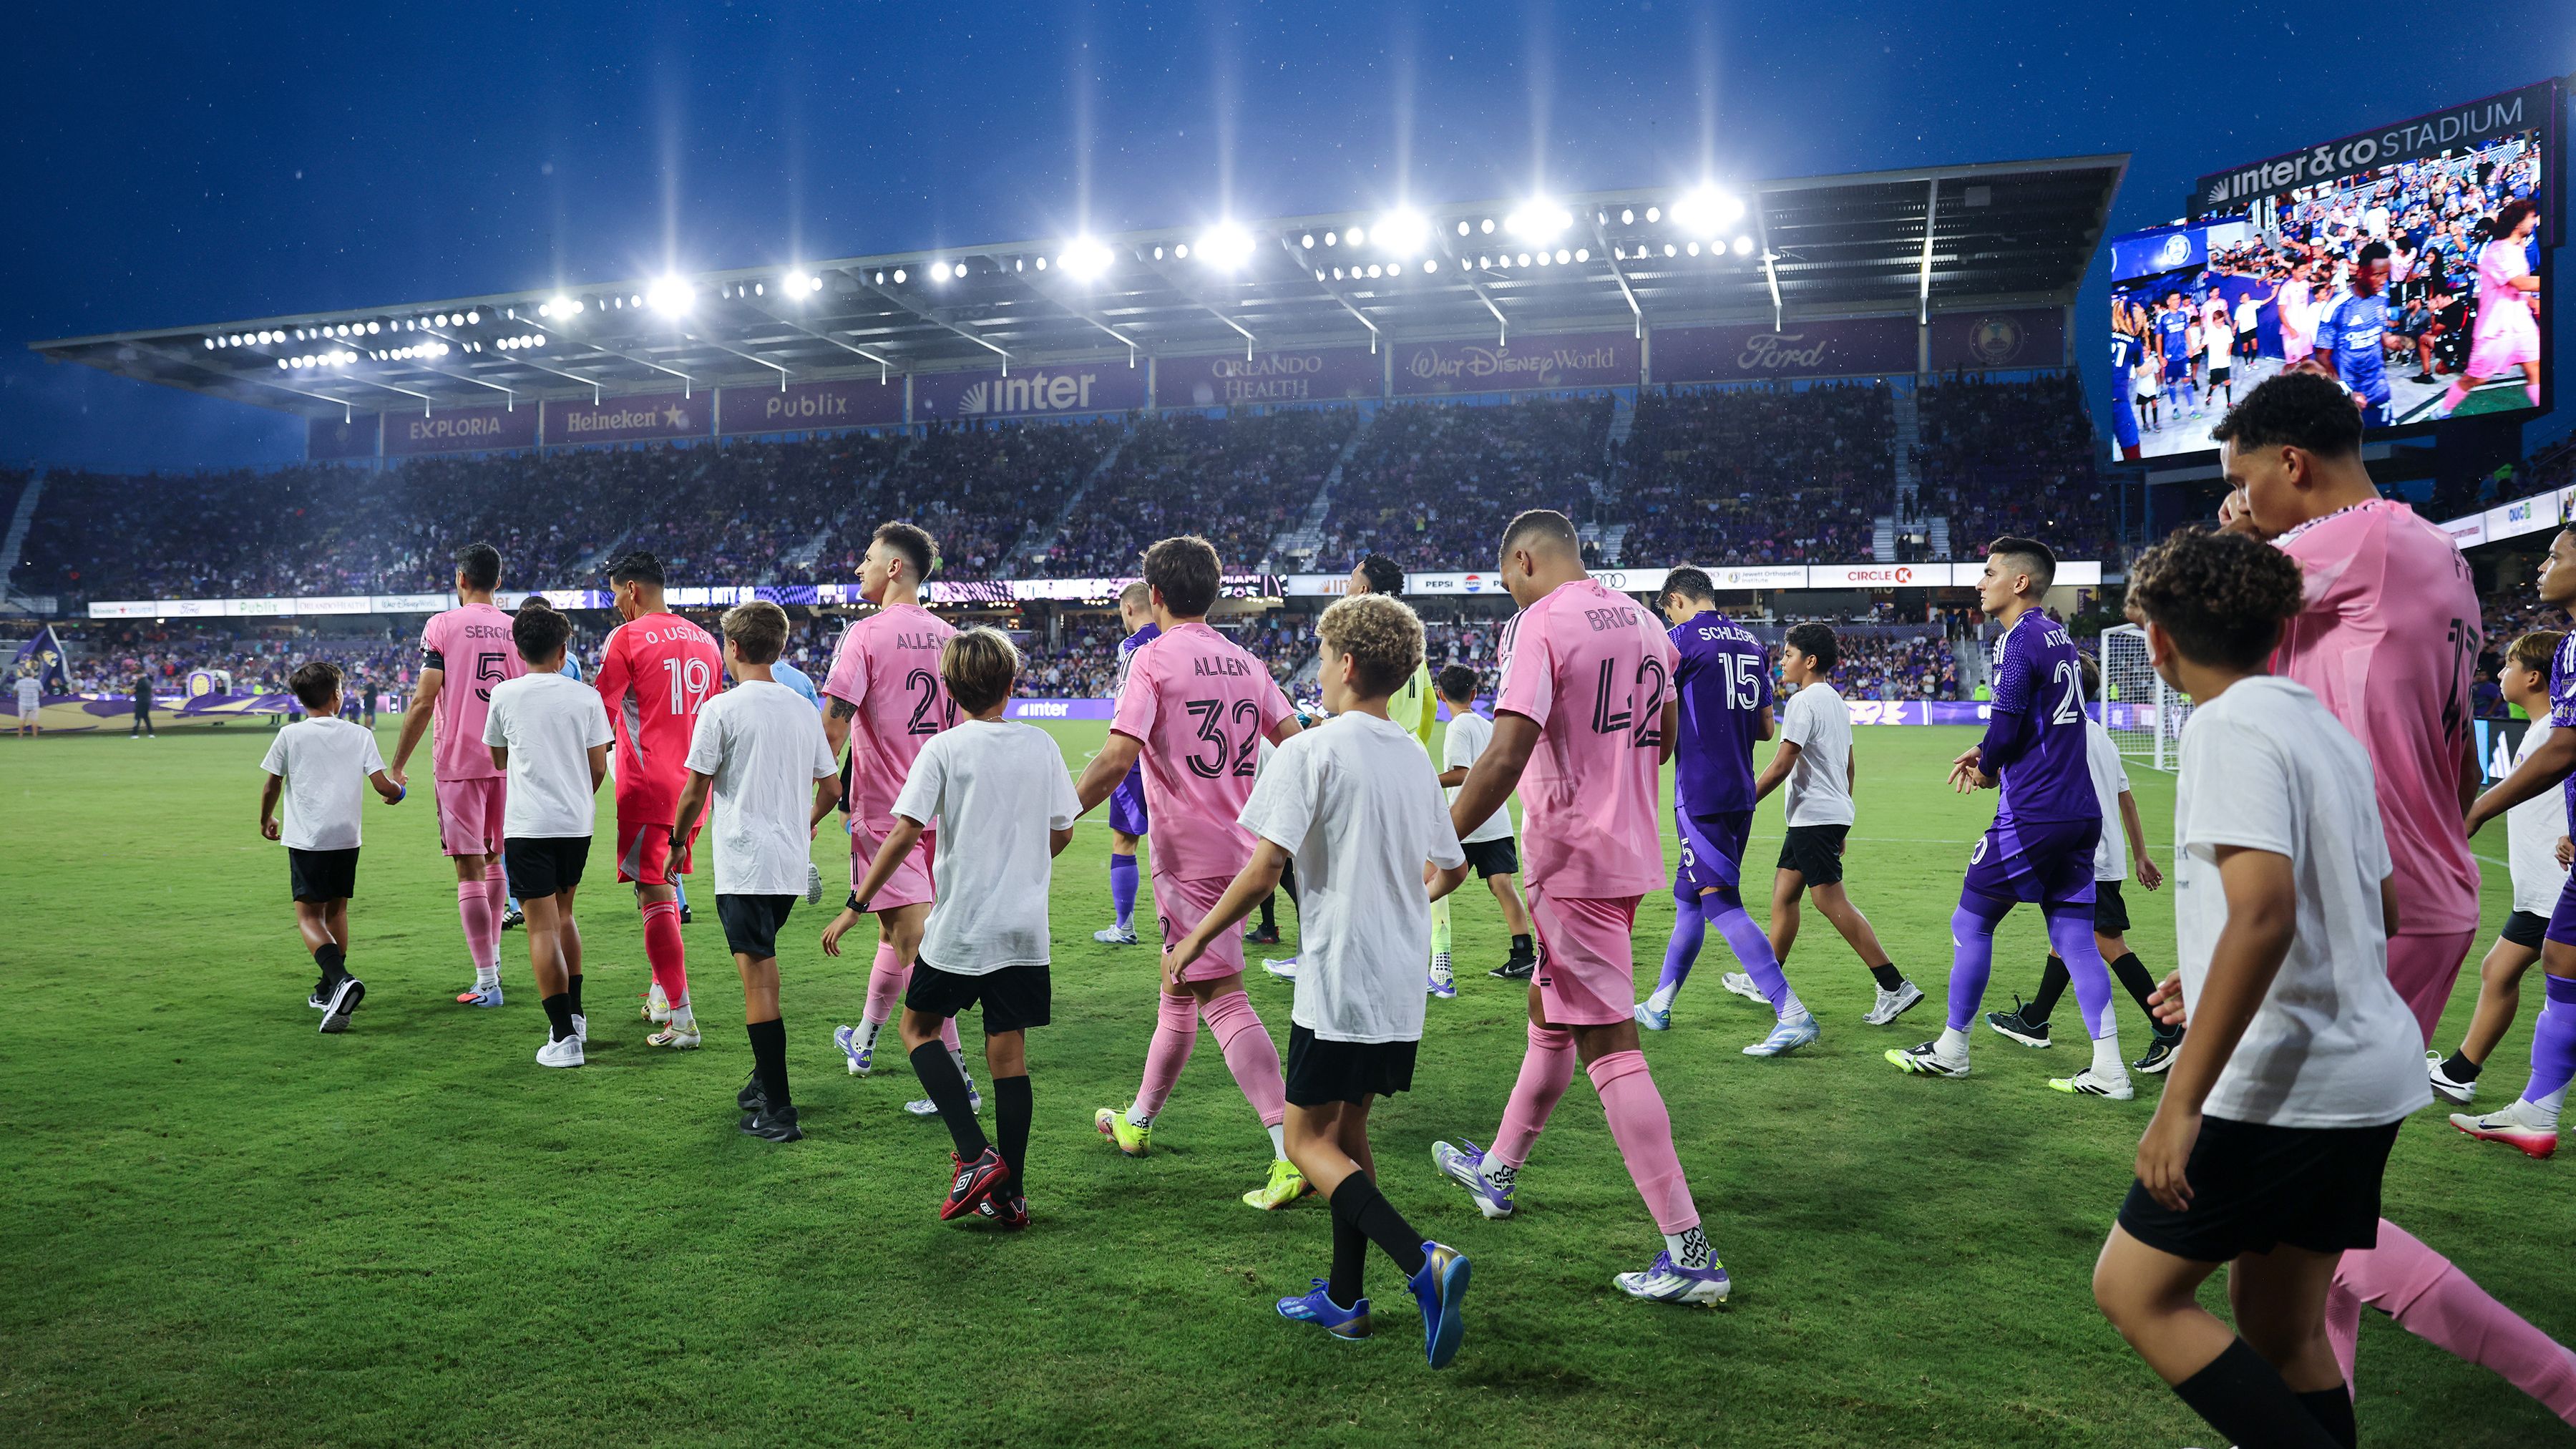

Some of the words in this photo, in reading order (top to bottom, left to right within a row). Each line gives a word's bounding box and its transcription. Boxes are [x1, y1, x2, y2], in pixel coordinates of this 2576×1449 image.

[2381, 96, 2523, 158] STADIUM
[1552, 348, 1615, 370] World
[1738, 332, 1824, 370] Ford
[1212, 356, 1322, 379] ORLANDO
[1225, 379, 1309, 399] HEALTH
[766, 393, 847, 419] Publix
[409, 417, 502, 440] EXPLORIA
[567, 410, 657, 433] Heineken
[1219, 575, 1261, 585] MIAMI
[1848, 572, 1892, 581] CIRCLE
[240, 602, 278, 613] Publix
[1698, 627, 1759, 646] SCHLEGEL
[2044, 628, 2074, 648] ATUE
[1194, 656, 1251, 676] ALLEN
[474, 653, 507, 703] 5
[663, 657, 711, 715] 19
[1718, 653, 1760, 711] 15
[1030, 701, 1069, 717] inter
[1591, 655, 1666, 749] 42
[1185, 698, 1259, 779] 32
[563, 1044, 581, 1055] NIK
